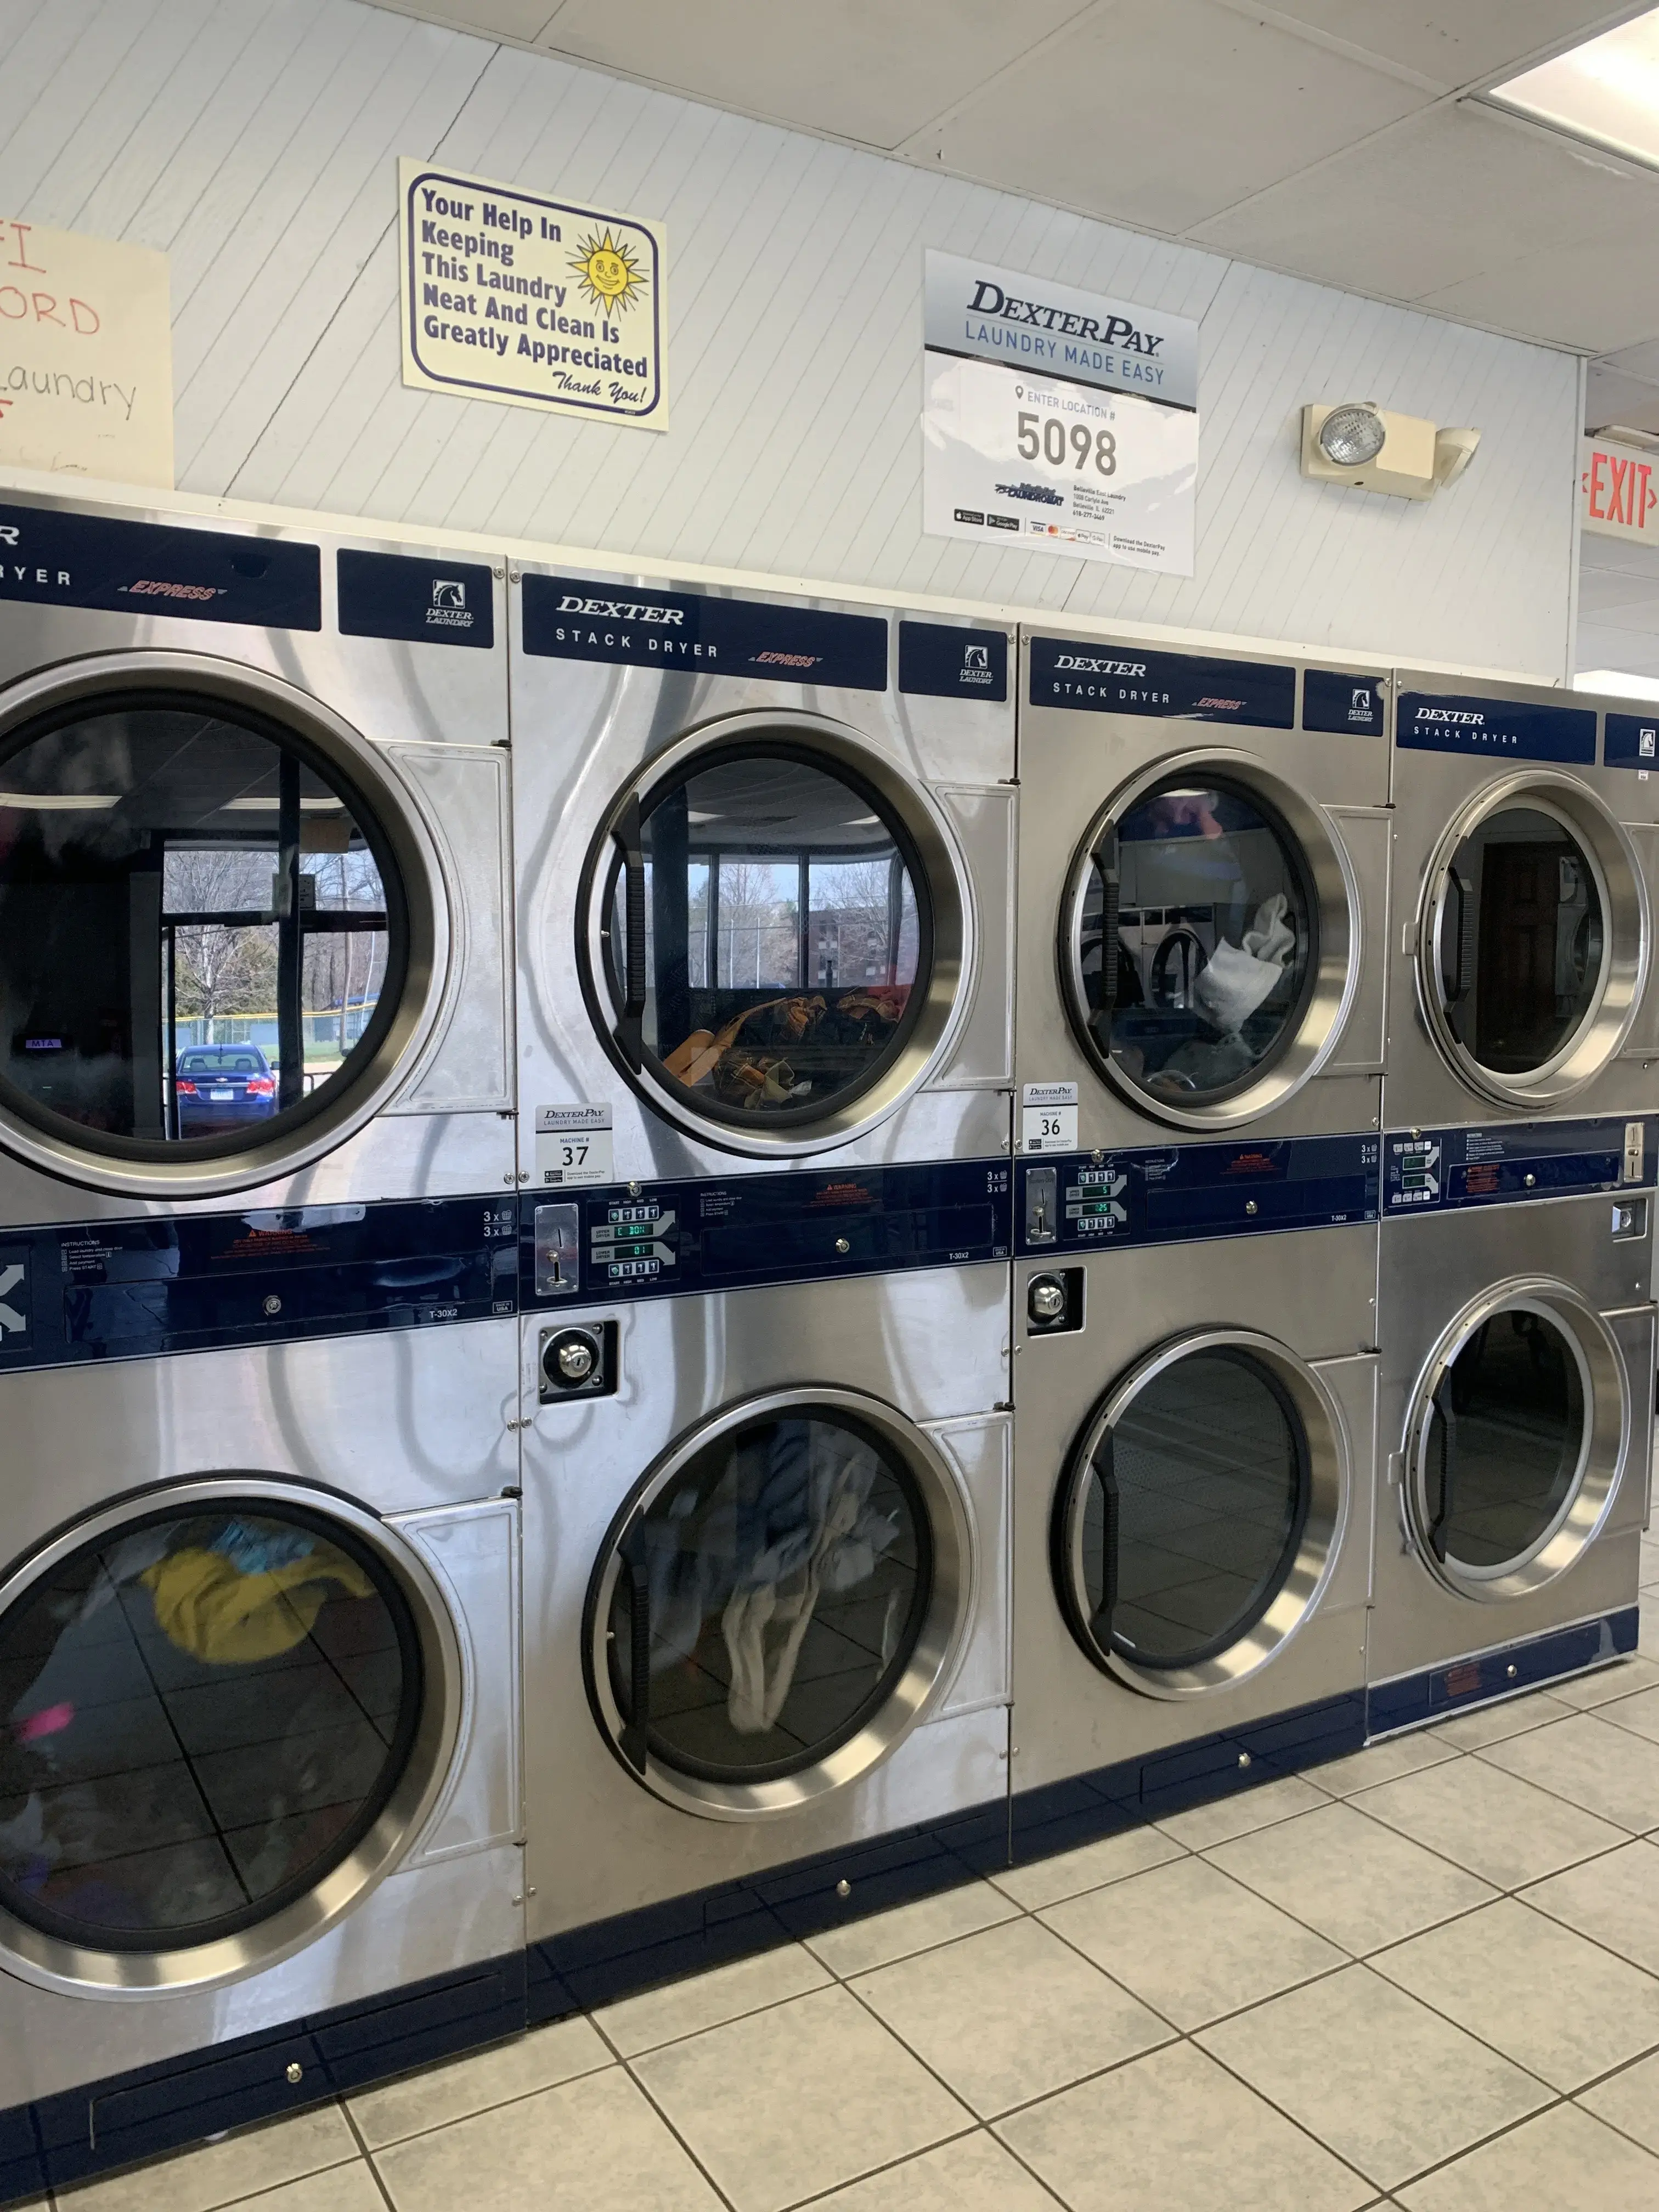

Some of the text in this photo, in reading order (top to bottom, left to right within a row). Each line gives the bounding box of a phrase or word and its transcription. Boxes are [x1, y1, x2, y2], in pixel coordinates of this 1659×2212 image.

[421, 187, 561, 242] Your Help In
[0, 222, 46, 273] I
[422, 220, 514, 266] Keeping
[422, 251, 567, 308] This Laundry
[423, 283, 619, 343] Neat And Clean Is
[424, 315, 648, 378] Greatly Appreciated
[966, 320, 1164, 386] LAUNDRY MADE EASY
[0, 365, 136, 420] aundry
[552, 371, 647, 405] Thank You!
[1028, 391, 1115, 421] ENTER LOCATION #
[1017, 411, 1116, 476] 5098
[1074, 485, 1096, 494] Belleville
[1108, 492, 1126, 501] Laundry
[1589, 452, 1651, 528] EXIT
[1073, 502, 1093, 511] Belleville
[1114, 535, 1135, 544] Download
[128, 580, 216, 601] EXPRESS
[426, 608, 473, 620] DEXTER
[556, 595, 684, 625] DEXTER
[426, 616, 473, 627] LAUNDRY
[556, 628, 817, 668] STACK DRYER EXPRESS
[960, 669, 992, 678] DEXTER
[1054, 654, 1146, 677] DEXTER
[959, 676, 993, 684] LAUNDRY
[1053, 682, 1241, 710] STACK DRYER EXPRESS
[1415, 707, 1484, 725] DEXTER
[1414, 726, 1517, 744] STACK DRYER
[1041, 1119, 1060, 1135] 36
[562, 1146, 589, 1166] 37
[1362, 1144, 1365, 1153] 3
[1362, 1155, 1365, 1164] 3
[988, 1171, 992, 1180] 3
[988, 1184, 992, 1193] 3
[484, 1211, 490, 1222] 3
[484, 1227, 490, 1237] 3
[430, 1308, 458, 1318] T-30X2
